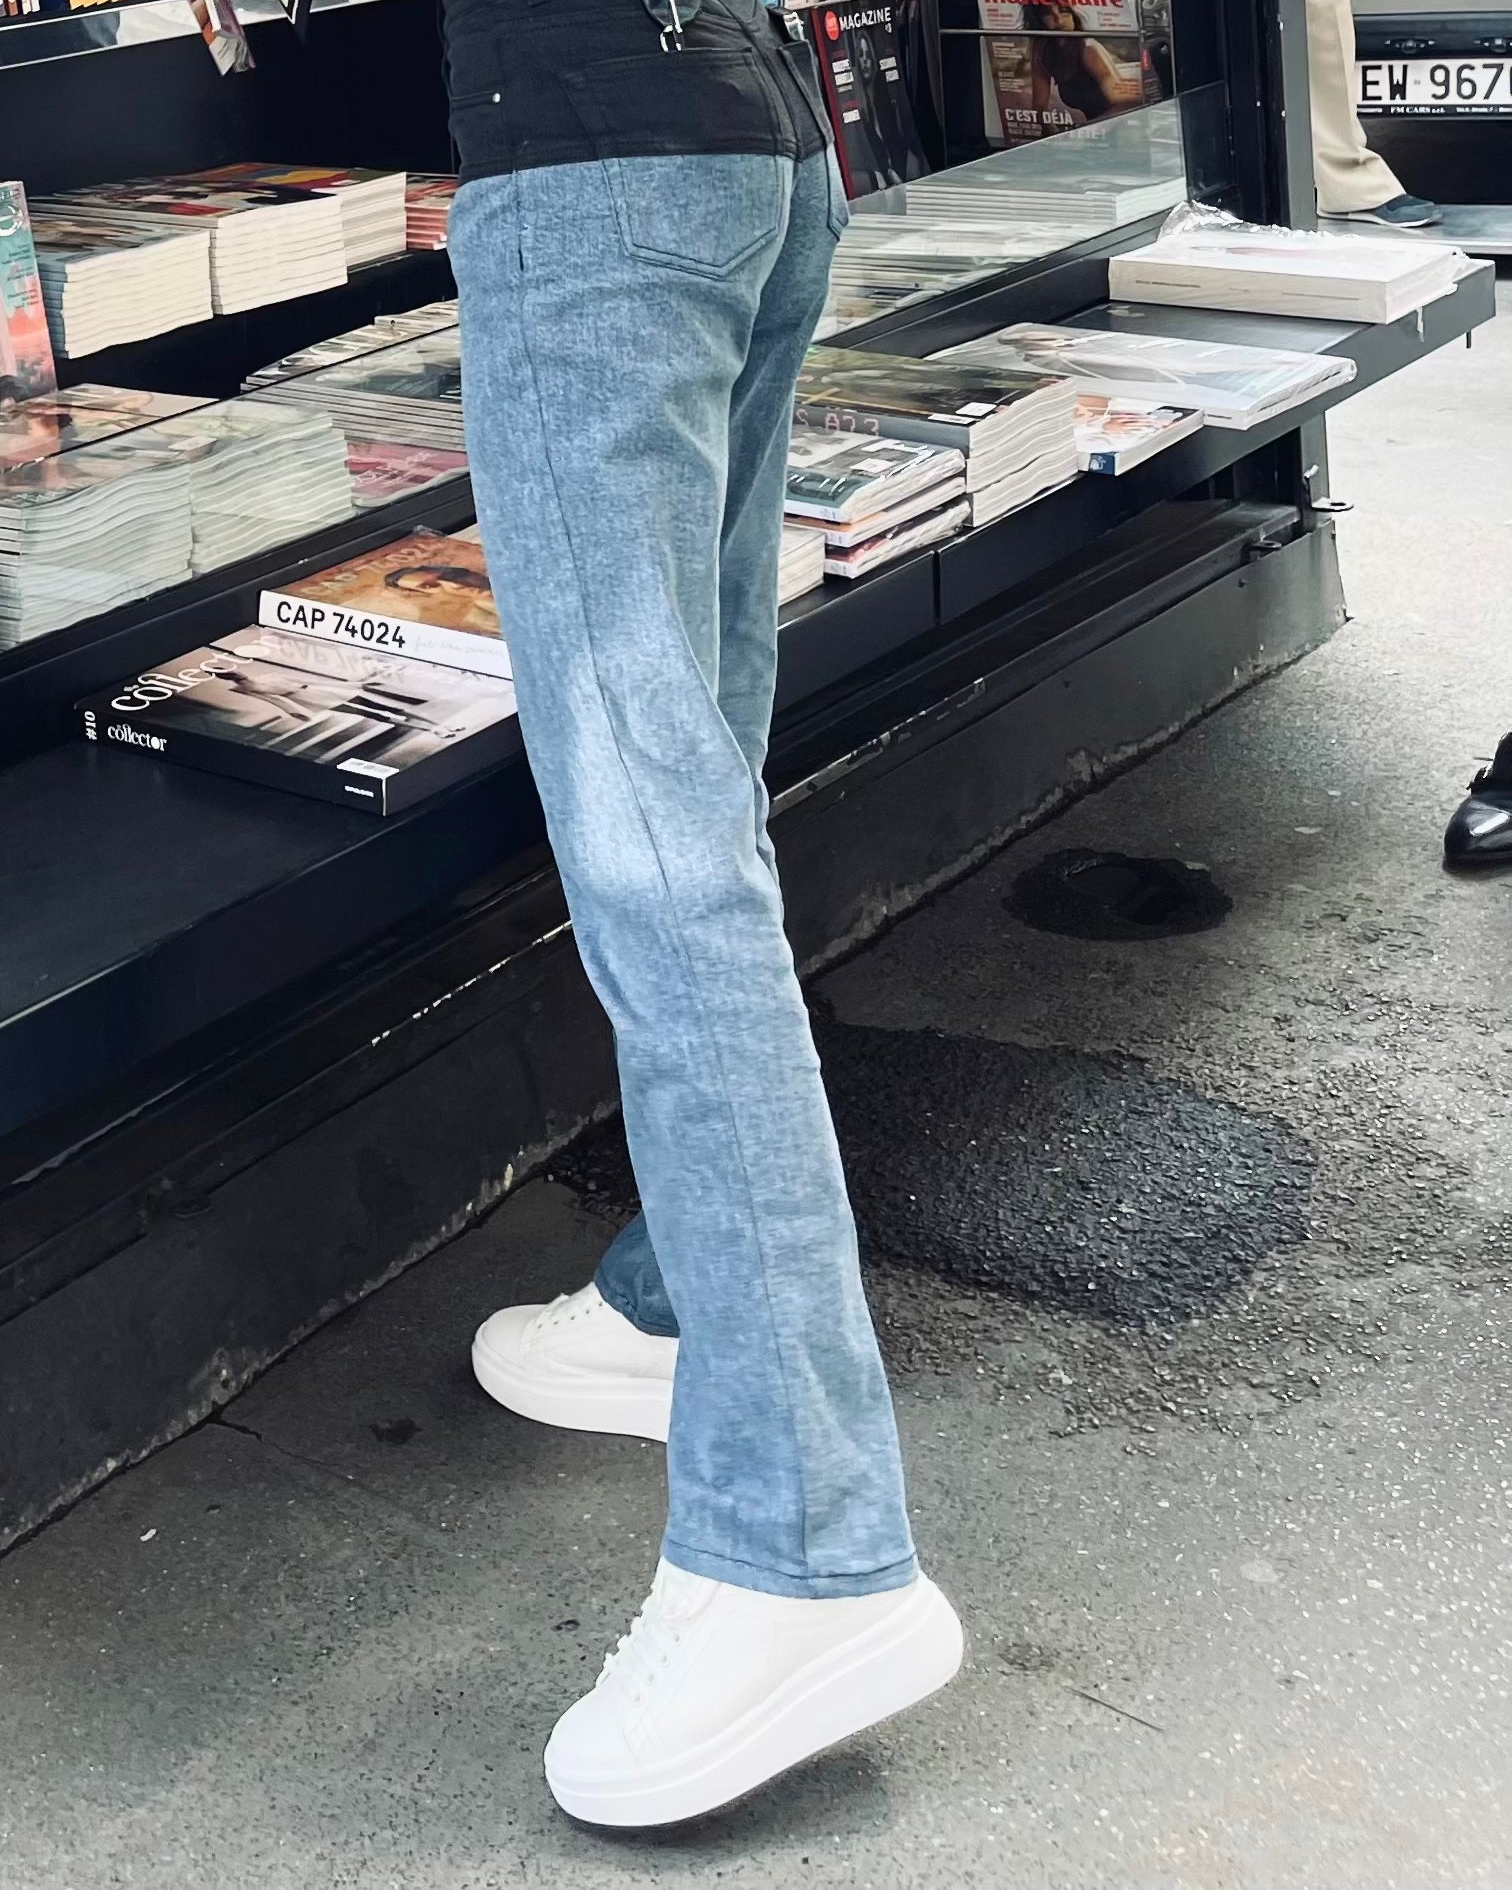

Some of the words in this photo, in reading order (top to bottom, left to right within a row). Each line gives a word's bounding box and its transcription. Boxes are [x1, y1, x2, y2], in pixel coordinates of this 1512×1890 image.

[838, 6, 892, 31] MAGAZINE
[1361, 63, 1408, 101] EW
[1429, 63, 1512, 101] 967
[1005, 108, 1038, 123] C'EST
[1042, 108, 1074, 125] DÉJÀ
[1406, 106, 1431, 114] CARS
[276, 600, 325, 629] CAP
[332, 610, 406, 649] 74024
[83, 710, 98, 741] #10
